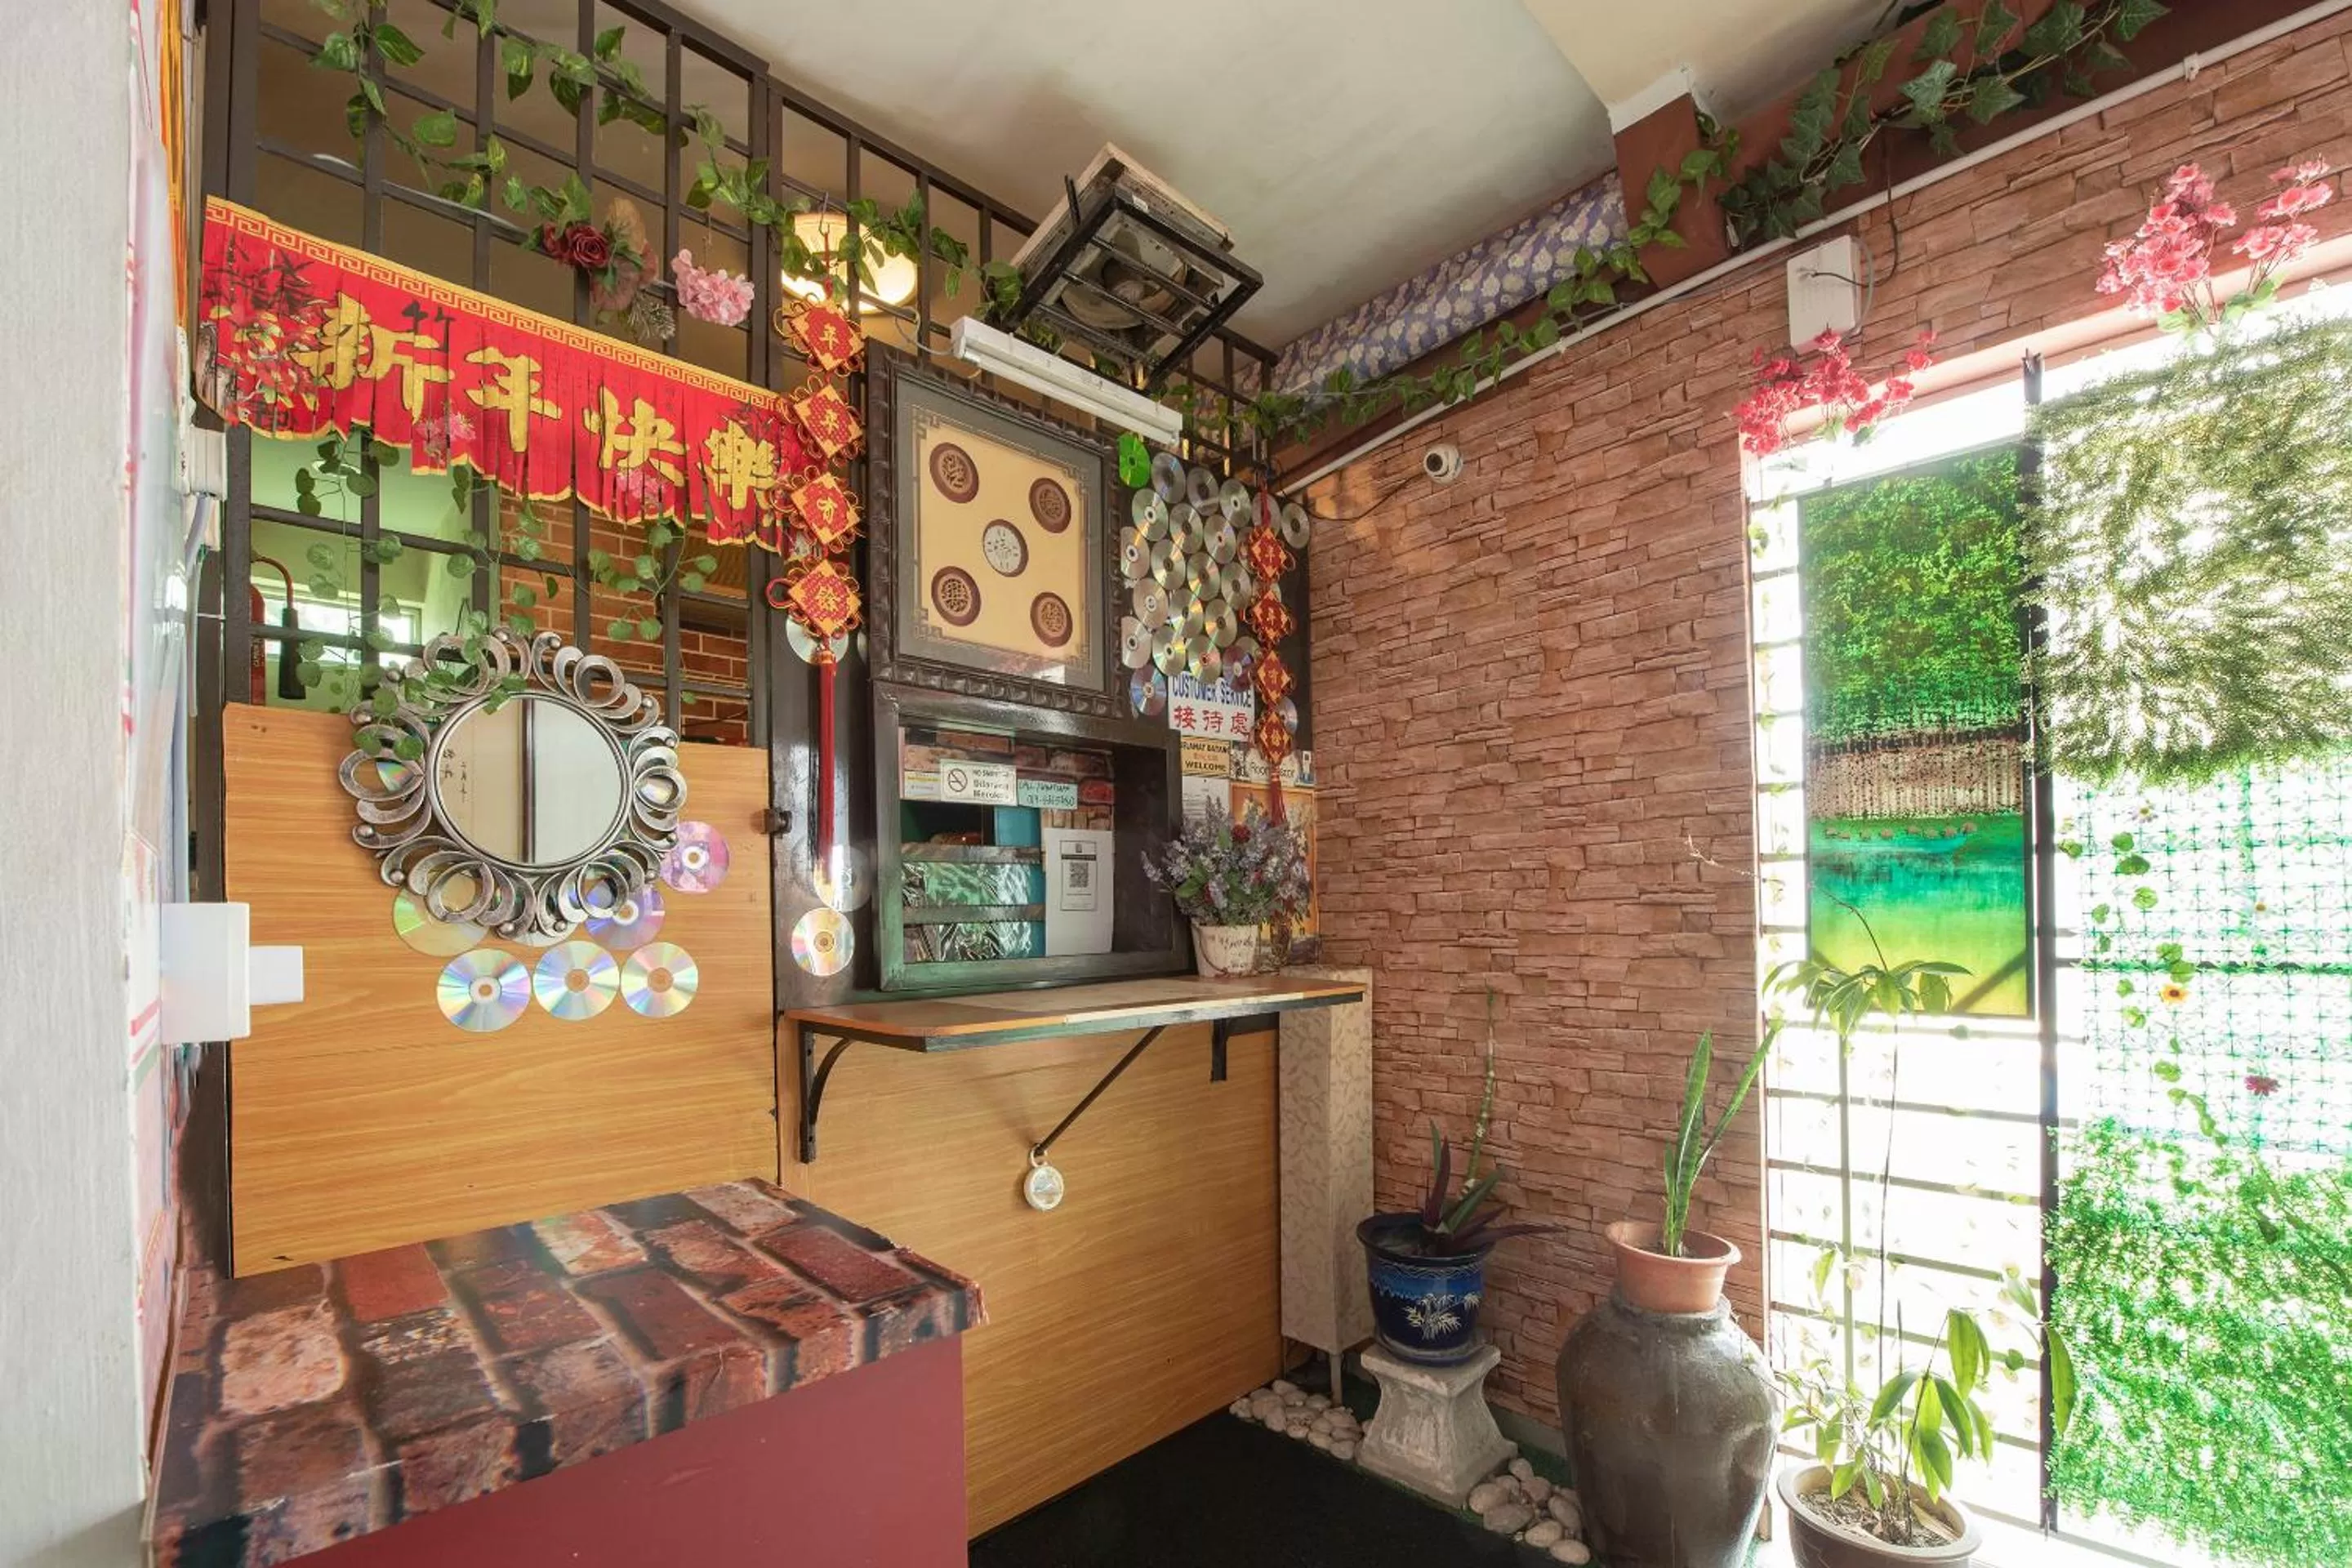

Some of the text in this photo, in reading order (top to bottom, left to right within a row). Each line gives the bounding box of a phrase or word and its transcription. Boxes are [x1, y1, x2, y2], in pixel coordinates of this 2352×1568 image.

[287, 291, 777, 510] 新年快樂
[1174, 705, 1251, 736] 接待處
[1185, 760, 1227, 772] WELCOME
